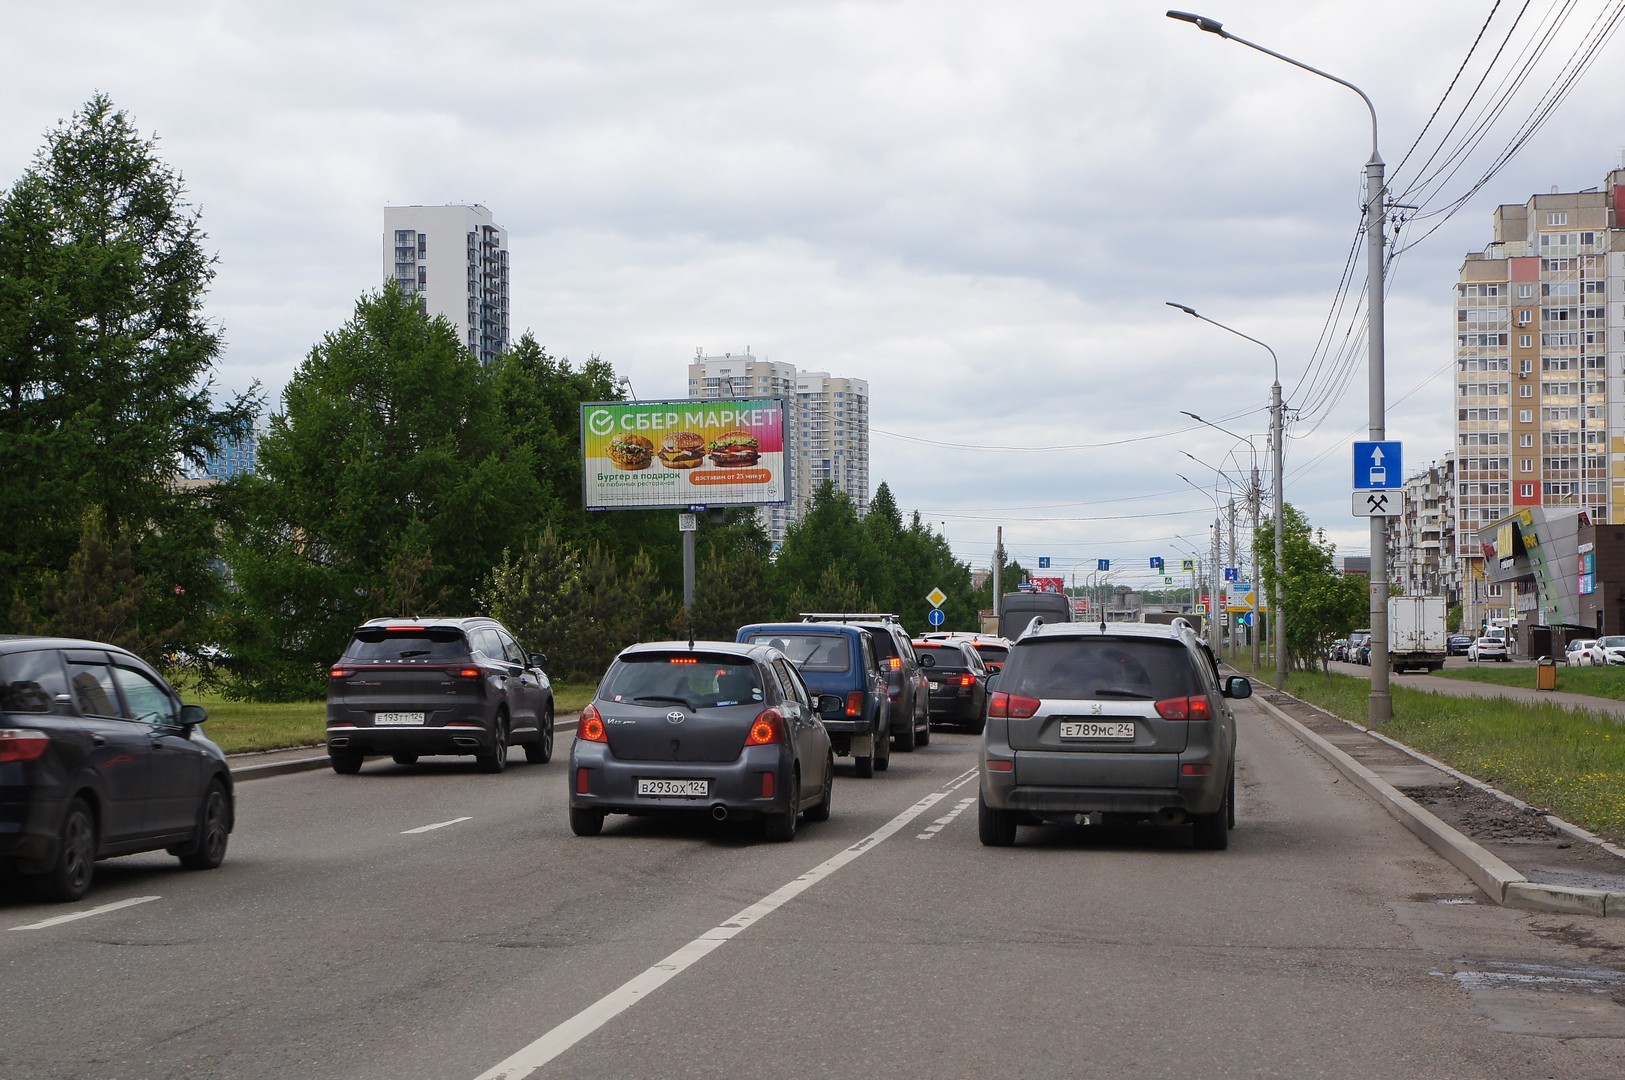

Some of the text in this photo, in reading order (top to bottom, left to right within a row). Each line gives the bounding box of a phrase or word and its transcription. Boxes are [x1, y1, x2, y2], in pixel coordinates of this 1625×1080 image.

[620, 408, 777, 431] СБЕР МАРКЕТ
[597, 472, 631, 482] Бургер
[640, 472, 681, 480] подарок
[1117, 723, 1130, 733] 24
[688, 781, 706, 791] 124
